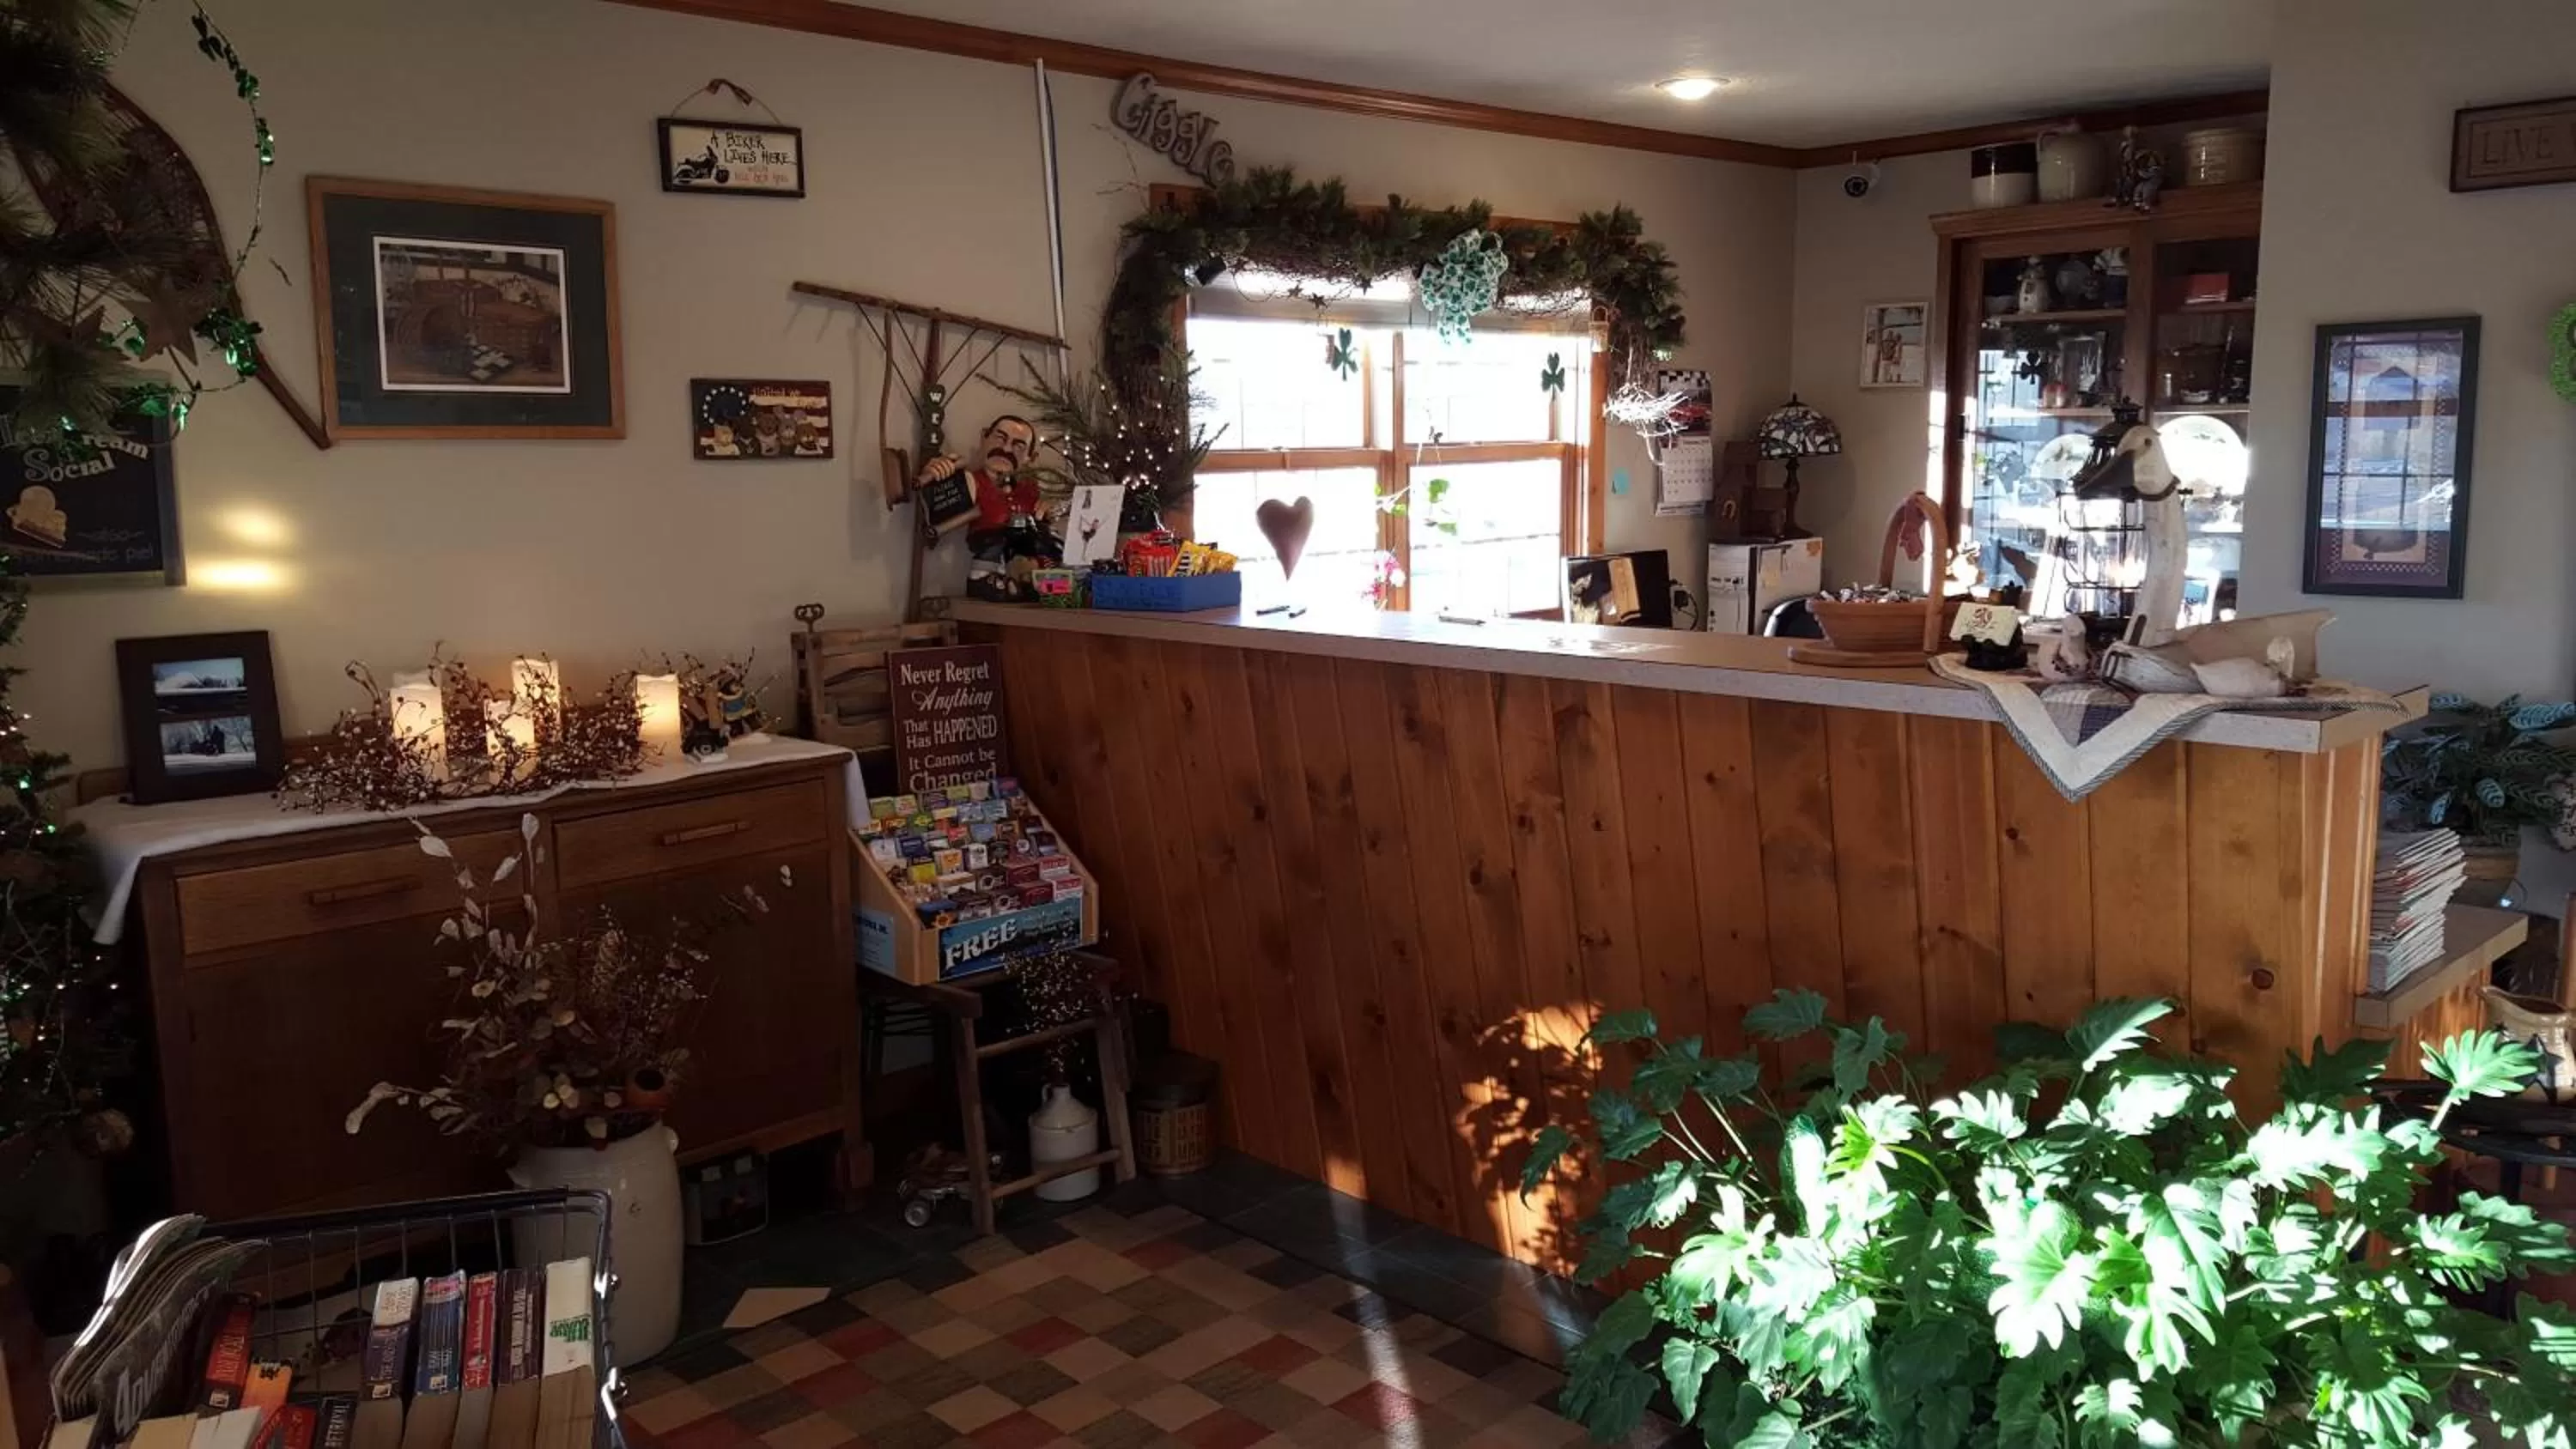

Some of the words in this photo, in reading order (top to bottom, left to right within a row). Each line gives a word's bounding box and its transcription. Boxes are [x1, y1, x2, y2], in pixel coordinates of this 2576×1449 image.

[710, 129, 720, 148] A
[726, 130, 765, 150] BIKER
[2481, 125, 2556, 165] LIVE
[723, 149, 756, 164] LIVES
[762, 150, 790, 165] HERE
[79, 431, 150, 461] ream
[22, 446, 118, 482] Social
[901, 663, 942, 686] Never
[945, 659, 990, 684] Regret
[911, 686, 994, 715] Anything
[903, 718, 929, 734] That
[933, 714, 998, 746] HAPPENED
[906, 734, 932, 749] Has
[908, 756, 921, 772] It
[924, 749, 975, 769] Cannot
[979, 747, 997, 762] be
[909, 761, 998, 794] Changed
[945, 918, 1018, 972] FREE
